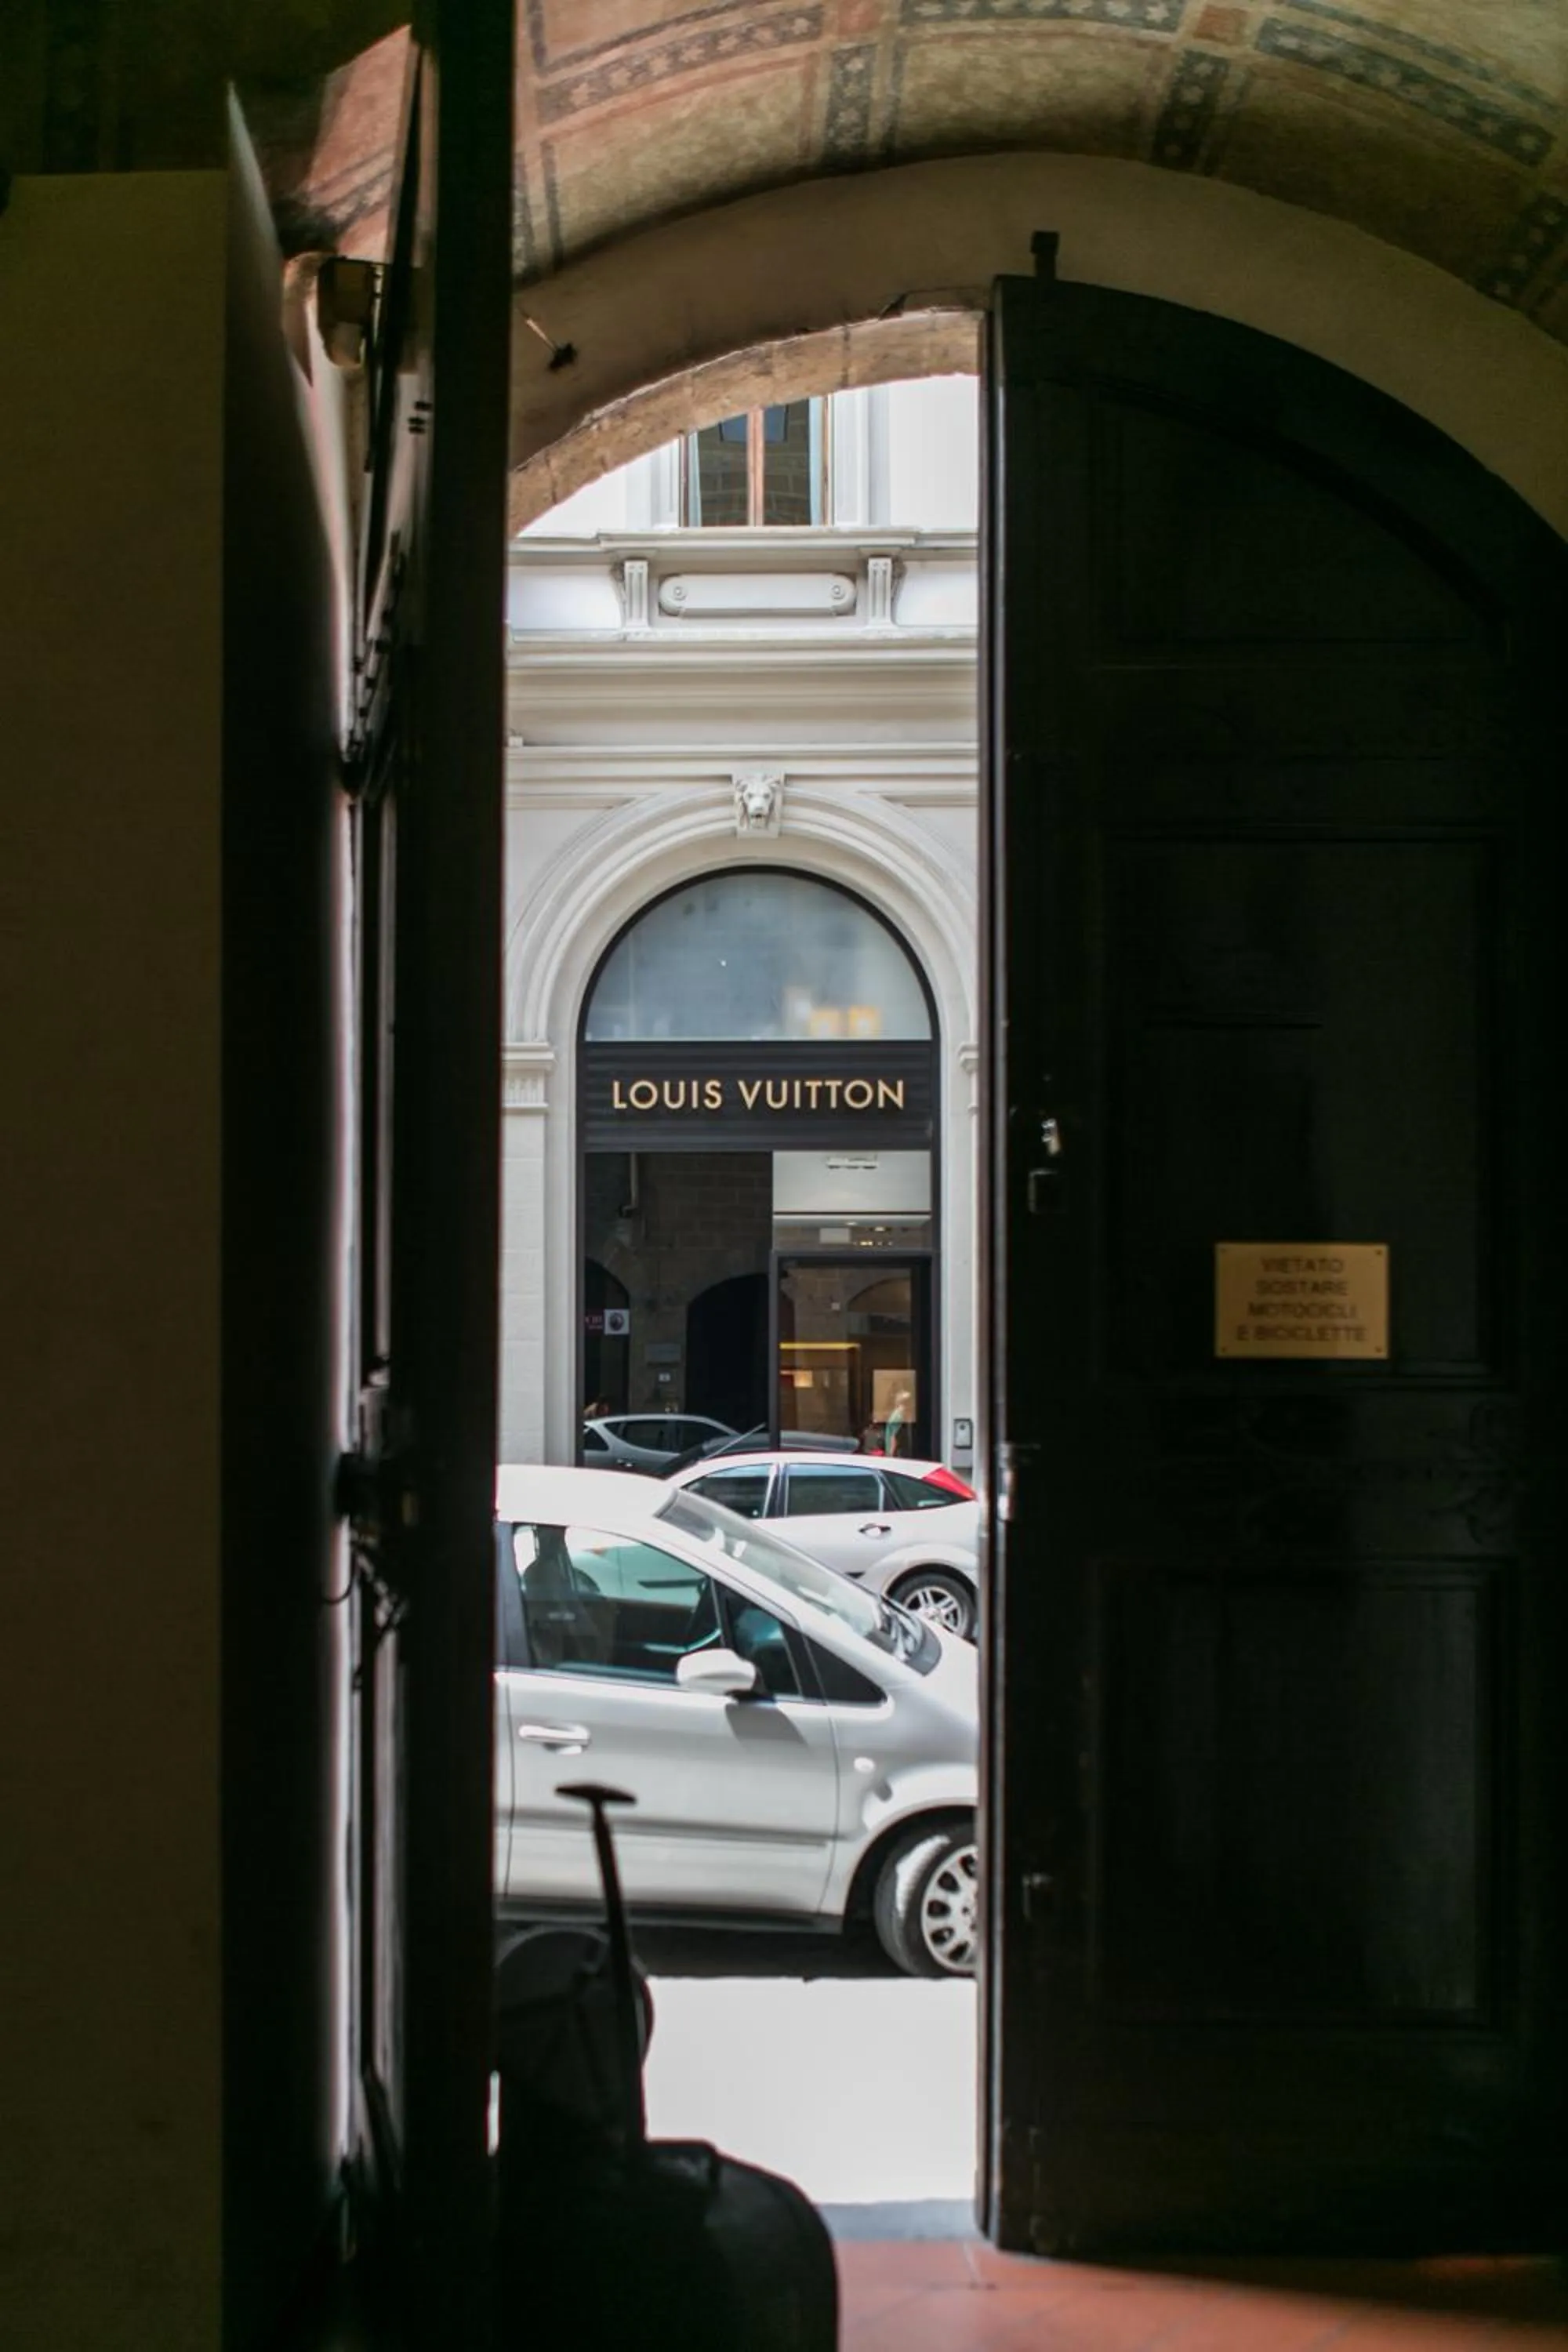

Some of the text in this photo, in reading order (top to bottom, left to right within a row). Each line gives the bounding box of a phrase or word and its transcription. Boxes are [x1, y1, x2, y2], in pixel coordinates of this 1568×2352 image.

[612, 1079, 905, 1110] LOUIS VUITTON
[1260, 1257, 1345, 1273] VIETATO
[1256, 1279, 1348, 1296] SOSTARE
[1247, 1301, 1358, 1319] MOTOCICLI
[1236, 1324, 1250, 1341] E
